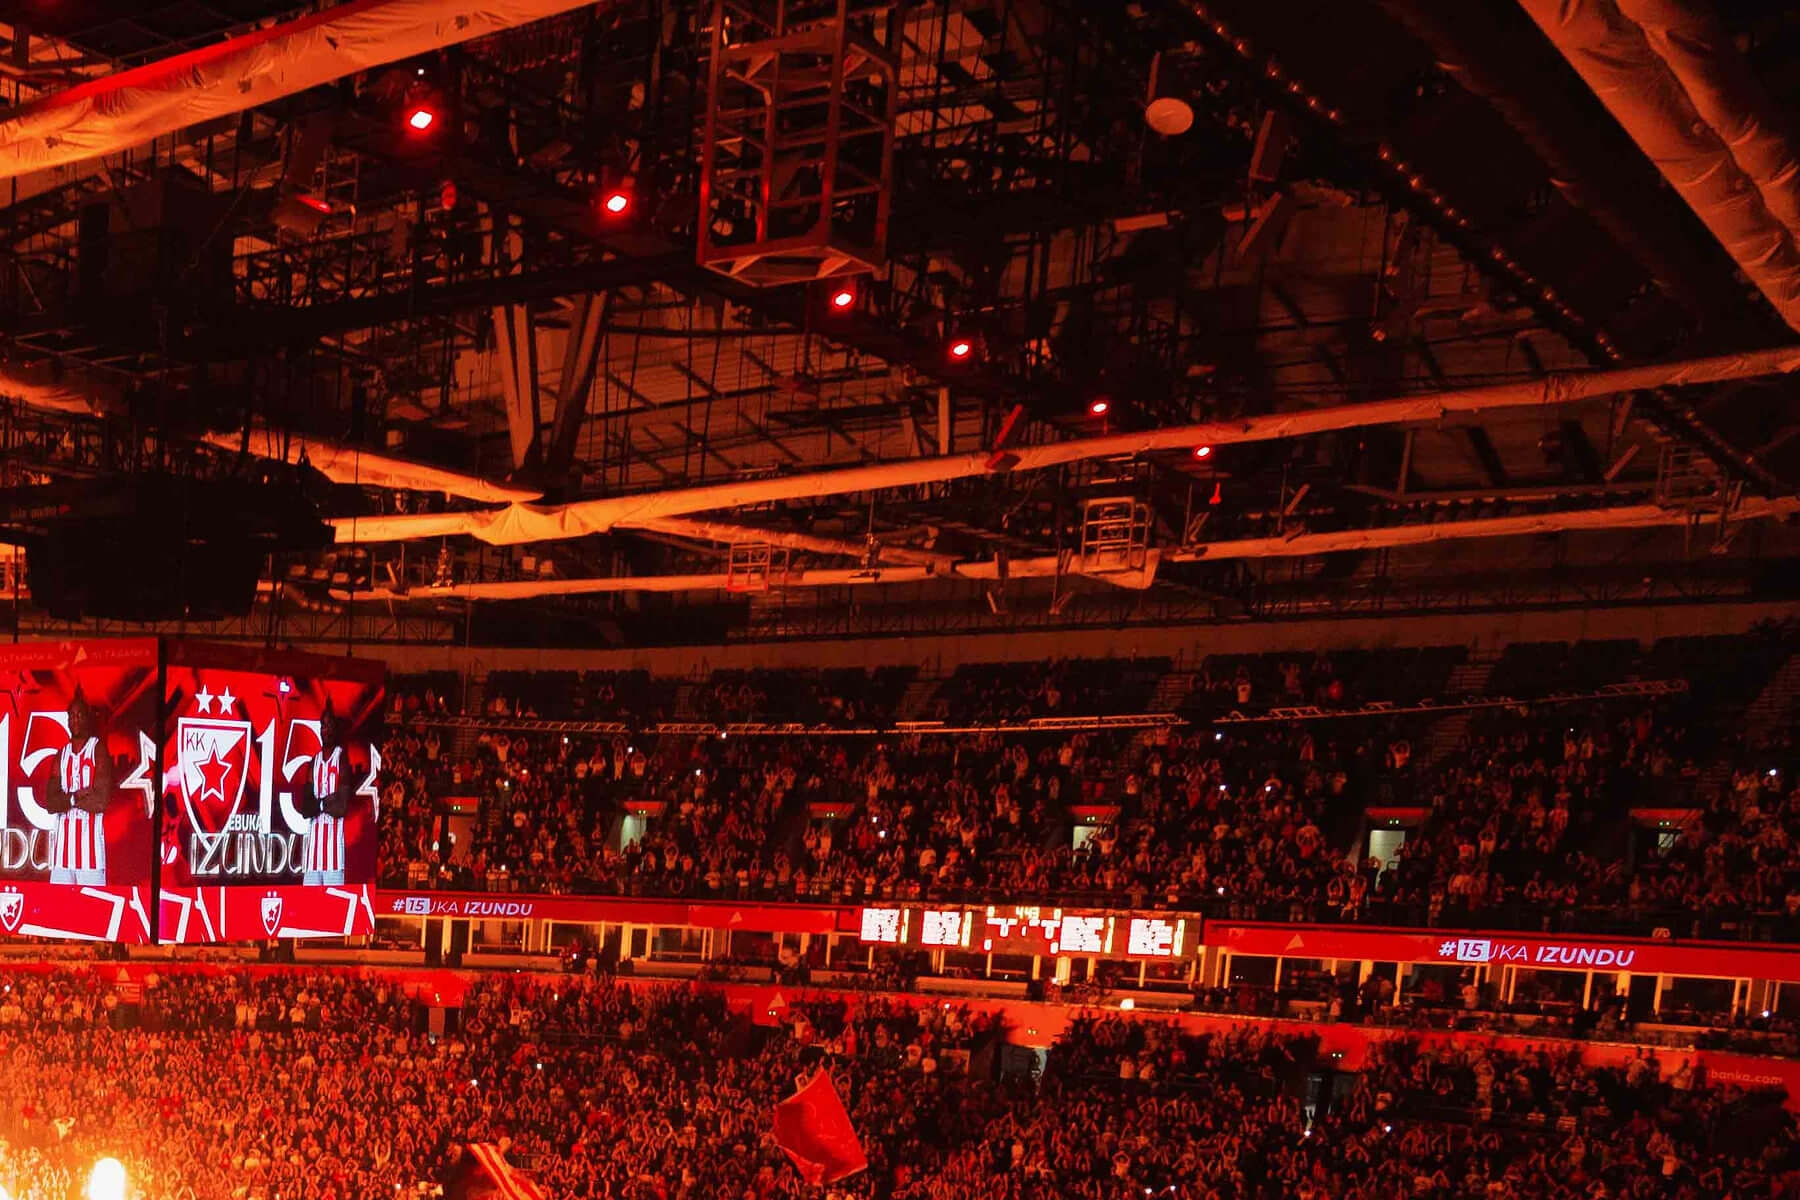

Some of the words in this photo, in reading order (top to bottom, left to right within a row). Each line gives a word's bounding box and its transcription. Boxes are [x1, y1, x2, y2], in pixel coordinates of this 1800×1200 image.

[185, 731, 206, 752] KK
[463, 901, 533, 915] IZUNDU
[1535, 946, 1635, 966] IZUNDU
